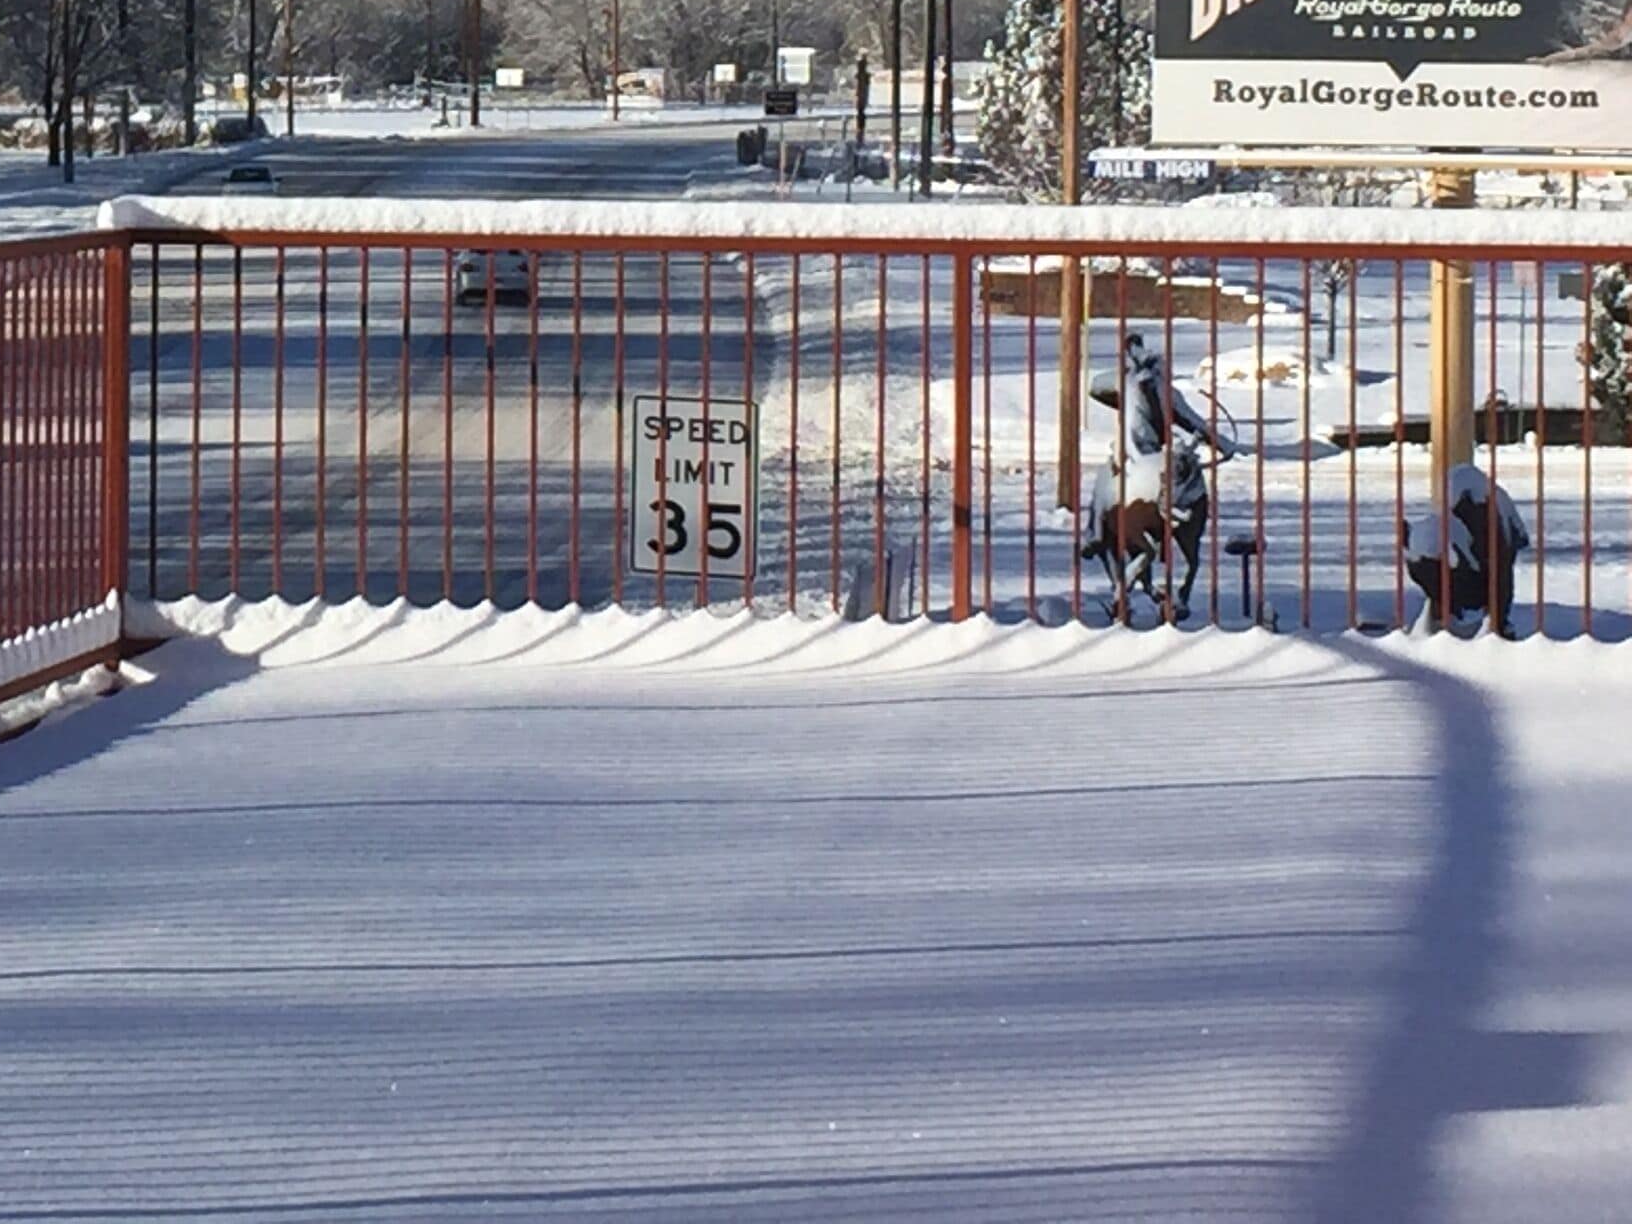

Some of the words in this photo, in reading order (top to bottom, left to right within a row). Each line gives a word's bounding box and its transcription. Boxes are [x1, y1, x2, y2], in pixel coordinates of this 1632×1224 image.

[1331, 24, 1477, 39] RAILROAD
[1212, 78, 1600, 111] RoyalGorgeRoute.com
[1094, 159, 1145, 178] MILE
[1155, 159, 1210, 178] HIGH
[643, 415, 750, 444] SPEED
[654, 457, 735, 486] LIMIT
[646, 499, 742, 559] 35
